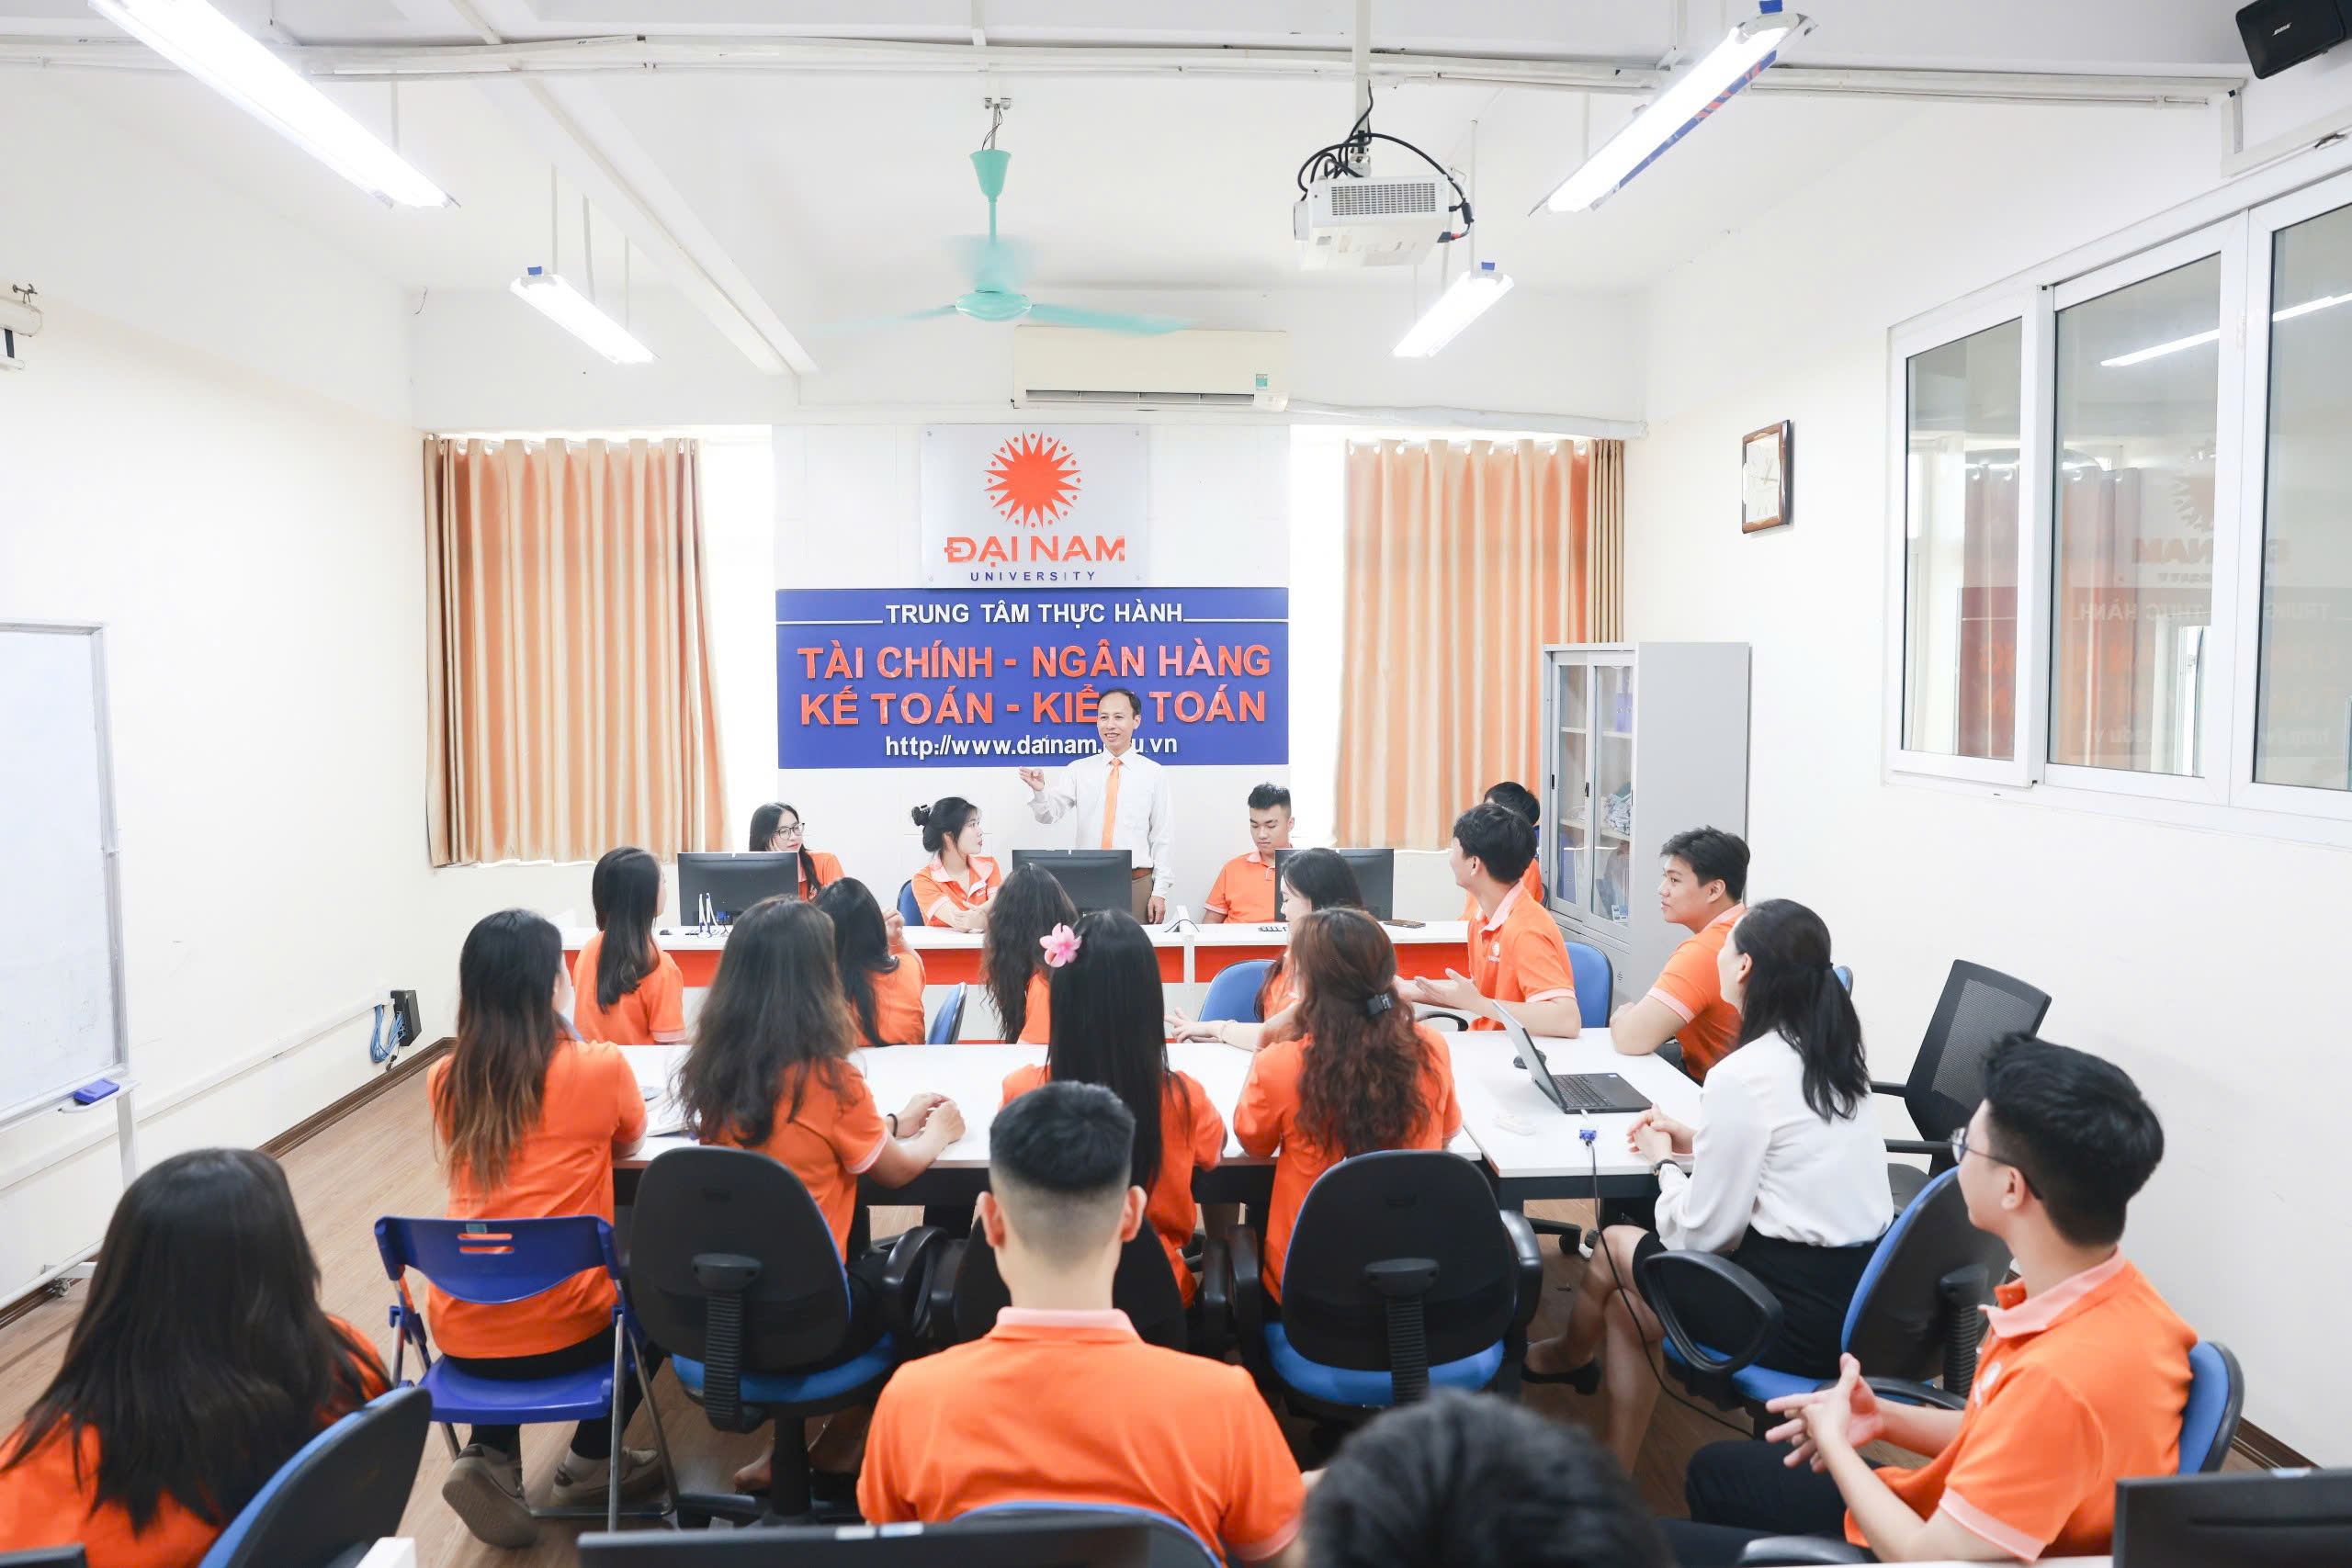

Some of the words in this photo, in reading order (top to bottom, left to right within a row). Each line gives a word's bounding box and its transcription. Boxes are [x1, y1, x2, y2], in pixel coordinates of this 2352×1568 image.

[944, 536, 1019, 568] ĐẠI
[1030, 536, 1125, 561] NAM
[970, 571, 1095, 581] UNIVERSITY
[885, 604, 969, 624] TRUNG
[980, 599, 1029, 623] TÂM
[1037, 603, 1105, 629] THỰC
[1114, 598, 1182, 623] HÀNH
[797, 639, 864, 679] TÀI
[876, 639, 992, 679] CHÍNH
[1033, 638, 1145, 678] NGÂN
[1159, 637, 1271, 677] HÀNG
[800, 685, 859, 725] KẾ
[870, 685, 993, 725] TOÁN
[1033, 683, 1135, 723] KIỂ
[1148, 684, 1265, 723] TOÁN
[886, 734, 1177, 759] http://www.dainam.uvn
